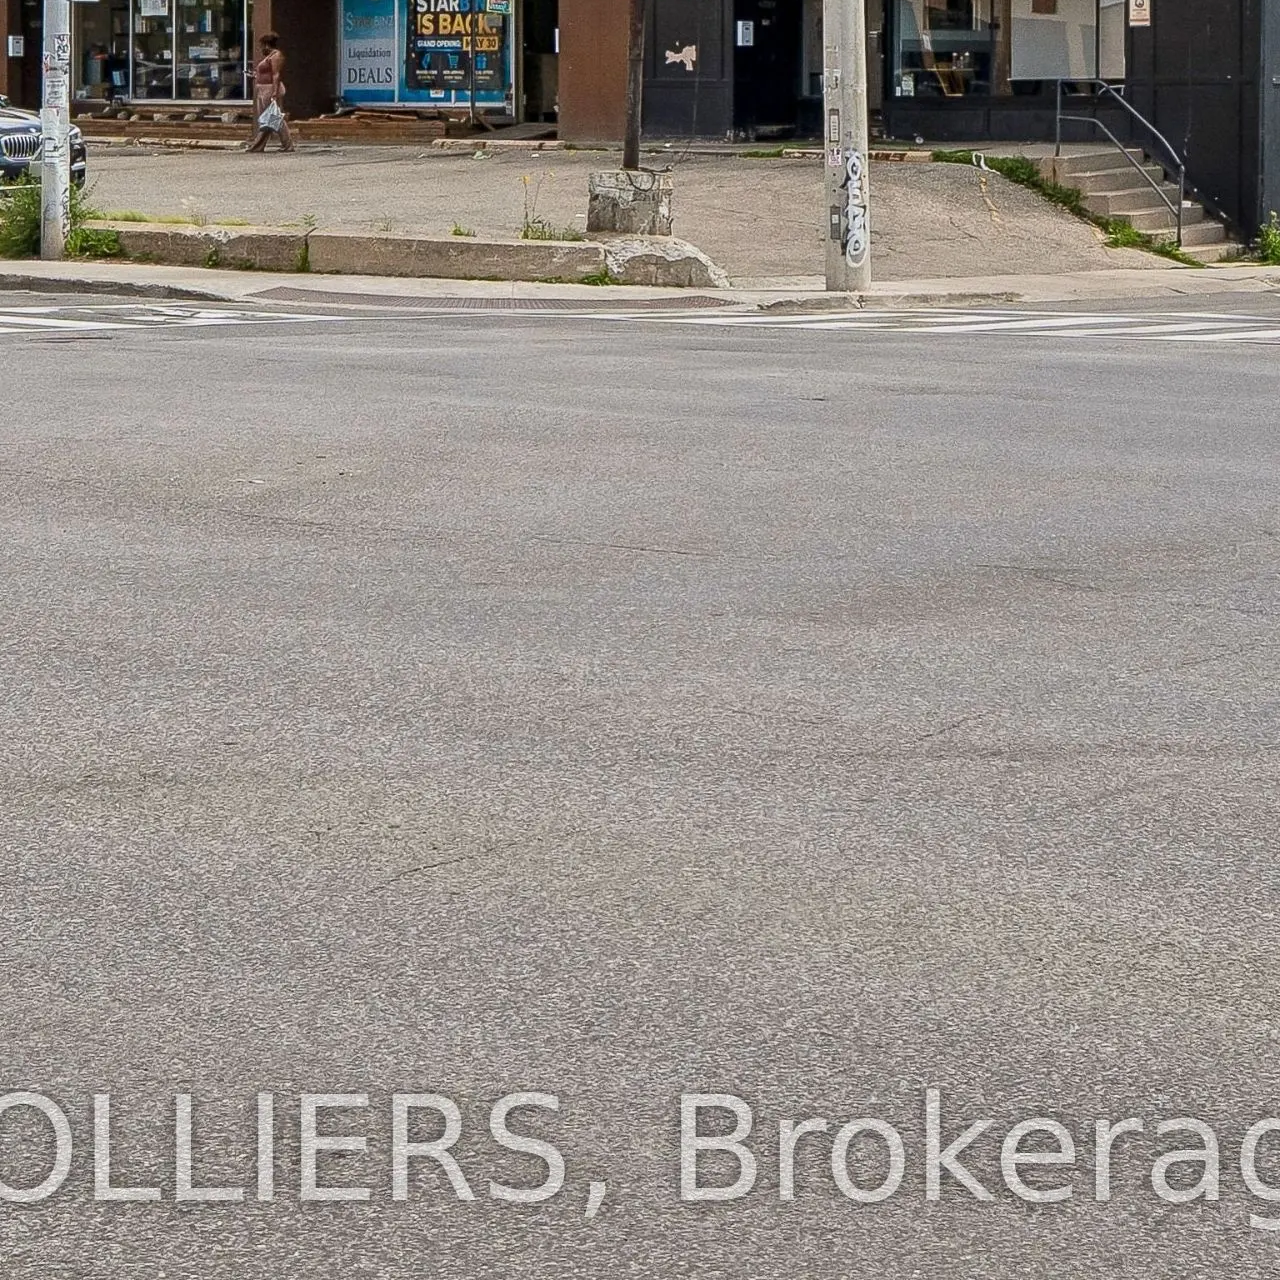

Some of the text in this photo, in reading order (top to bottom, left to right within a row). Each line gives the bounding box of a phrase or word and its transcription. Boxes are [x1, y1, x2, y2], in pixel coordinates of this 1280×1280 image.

[417, 13, 434, 36] IS
[486, 38, 497, 48] 30
[348, 47, 391, 59] Liquidation
[347, 67, 393, 84] DEALS
